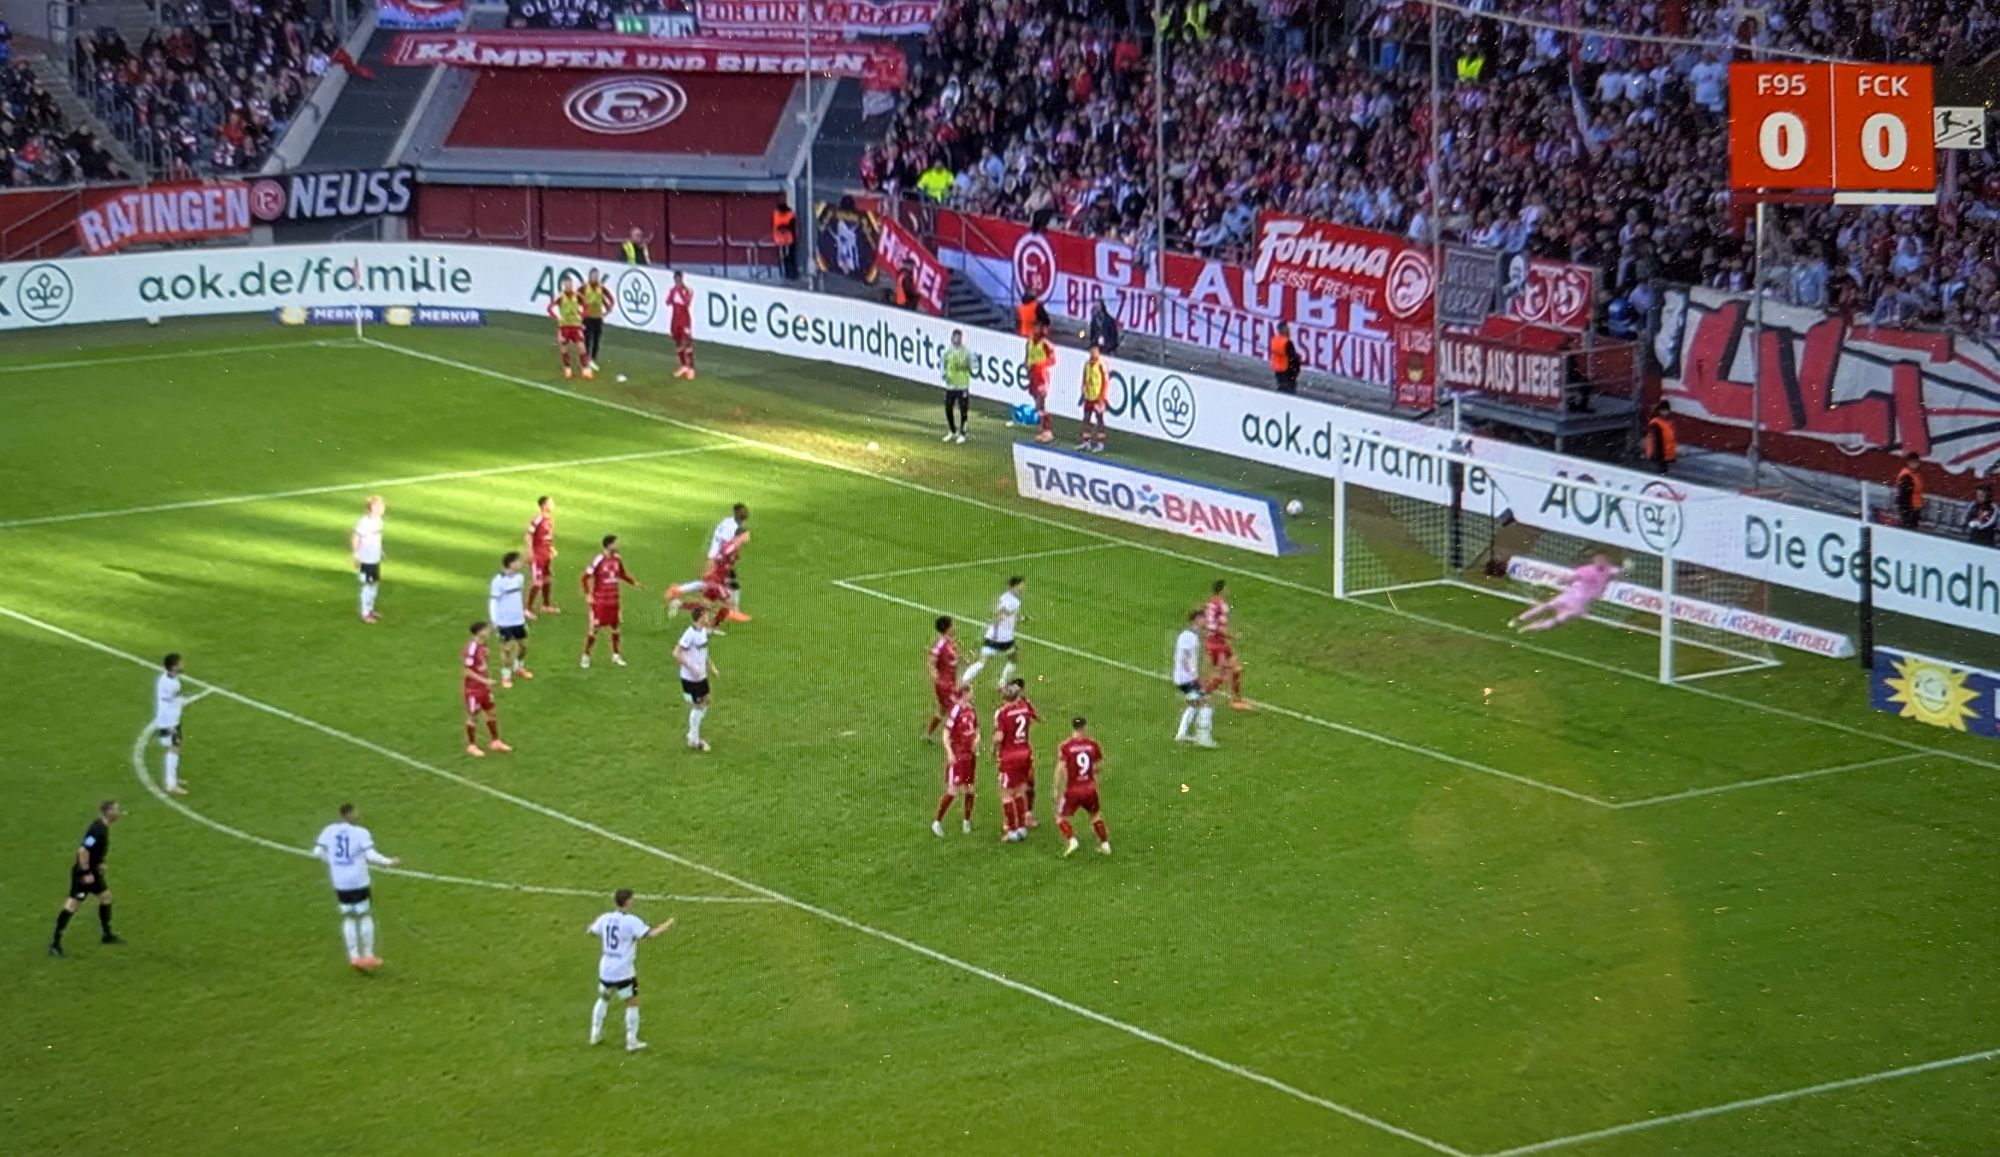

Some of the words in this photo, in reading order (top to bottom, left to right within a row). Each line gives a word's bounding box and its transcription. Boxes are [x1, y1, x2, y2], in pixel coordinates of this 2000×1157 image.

[416, 40, 628, 68] KÄMPFEN
[636, 54, 706, 70] UND
[715, 53, 867, 73] SIEGEN
[1757, 74, 1807, 96] F95
[1858, 76, 1908, 97] FCK
[1759, 111, 1807, 170] 0
[1861, 112, 1908, 171] 0
[288, 171, 411, 219] NEUSS
[80, 188, 248, 251] RATINGEN
[1255, 221, 1390, 284] Fortuna
[139, 257, 472, 302] aok.de/familie
[314, 308, 375, 321] MERKUR
[419, 309, 481, 322] MERKUR
[708, 291, 757, 333] Die
[766, 302, 1030, 391] Gesundheitsasse
[1485, 349, 1515, 393] AUS
[1518, 354, 1560, 399] LIEBE
[1540, 470, 1631, 534] AOK
[1745, 515, 1806, 569] Die
[1015, 714, 1026, 738] 2
[1076, 752, 1090, 775] 9
[335, 834, 349, 859] 31
[606, 924, 619, 949] 15
